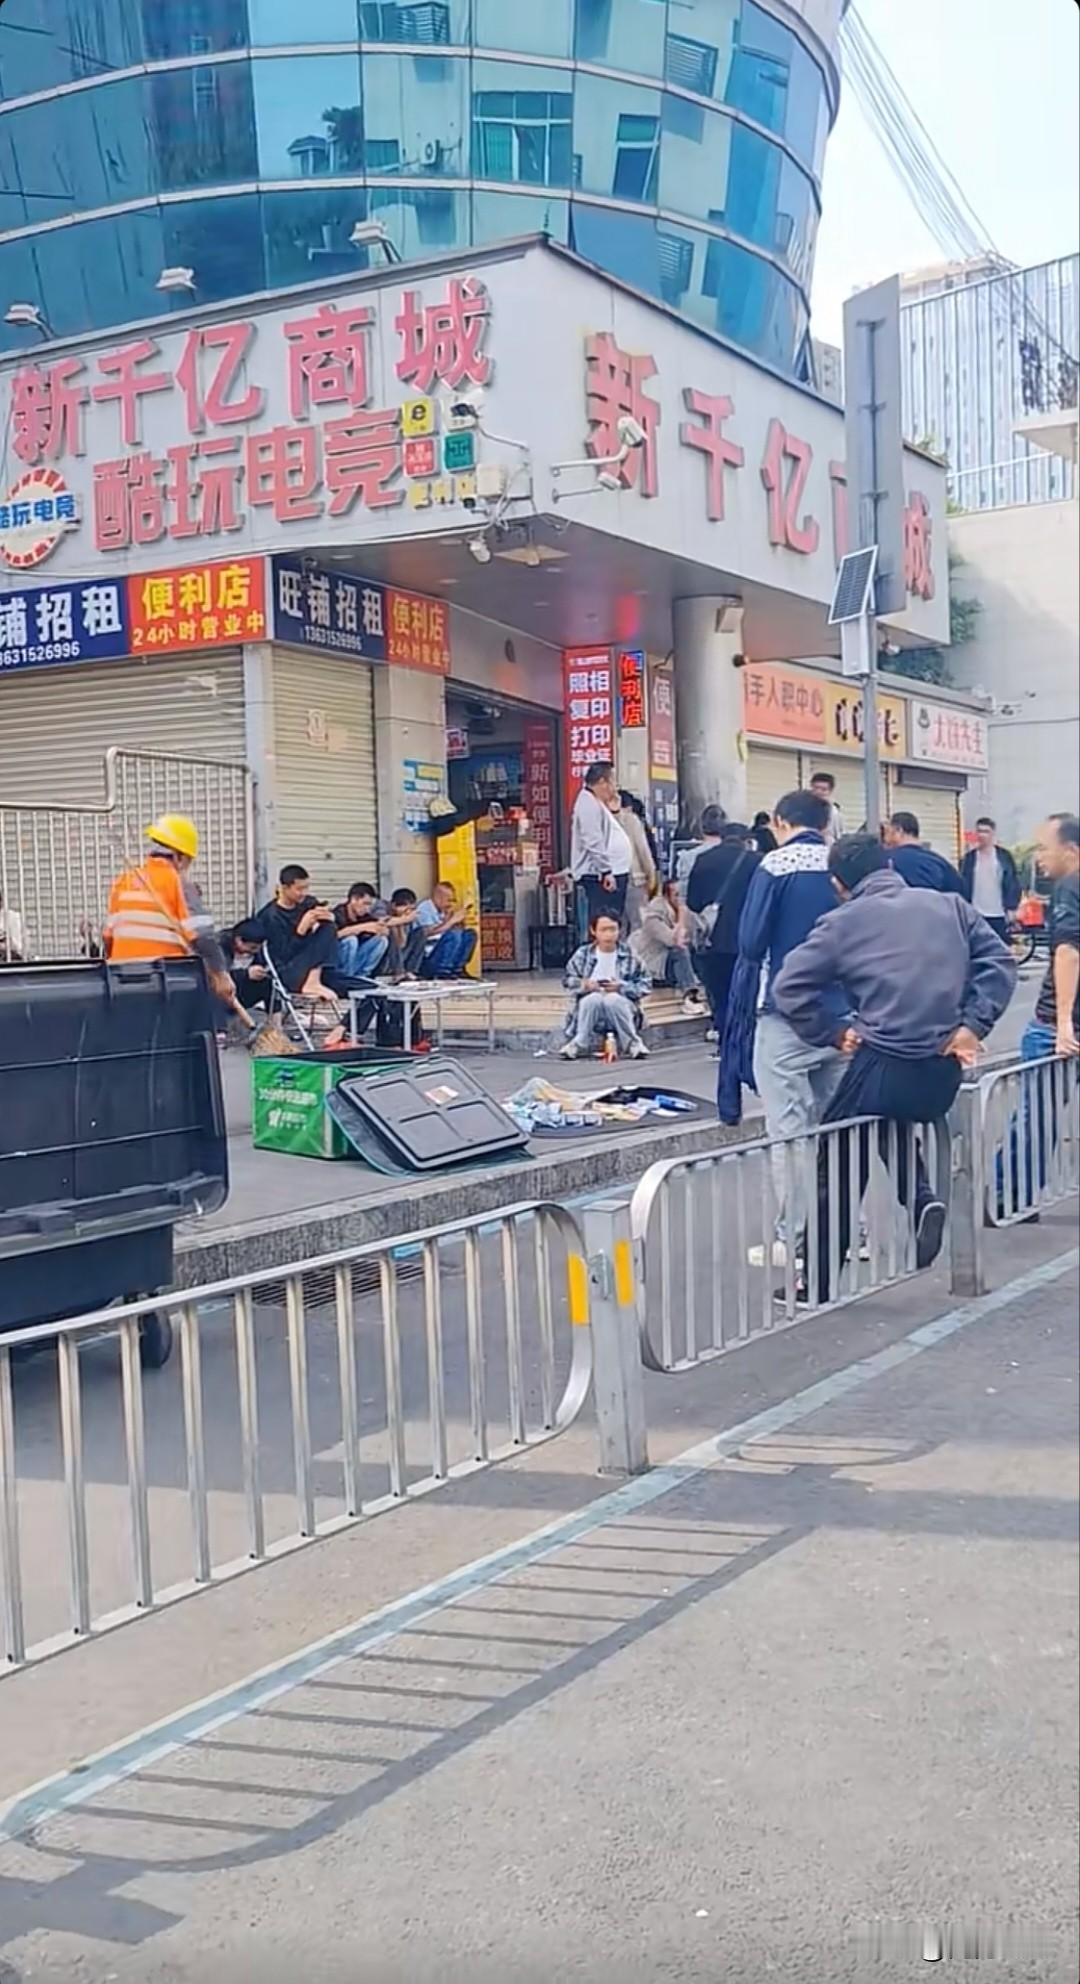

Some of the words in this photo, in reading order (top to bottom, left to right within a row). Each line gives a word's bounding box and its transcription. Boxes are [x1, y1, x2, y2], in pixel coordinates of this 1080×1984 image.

[10, 277, 494, 464] 新千亿商城
[92, 407, 404, 552] 酷玩电竞
[584, 331, 936, 602] 新千亿城
[142, 564, 251, 621] 便利店
[279, 569, 385, 637] 旺铺招租
[393, 592, 445, 642] 便利店
[132, 609, 264, 647] 24小时营业中
[569, 669, 609, 694] 照相
[570, 697, 611, 721] 复印
[570, 724, 611, 749] 打印
